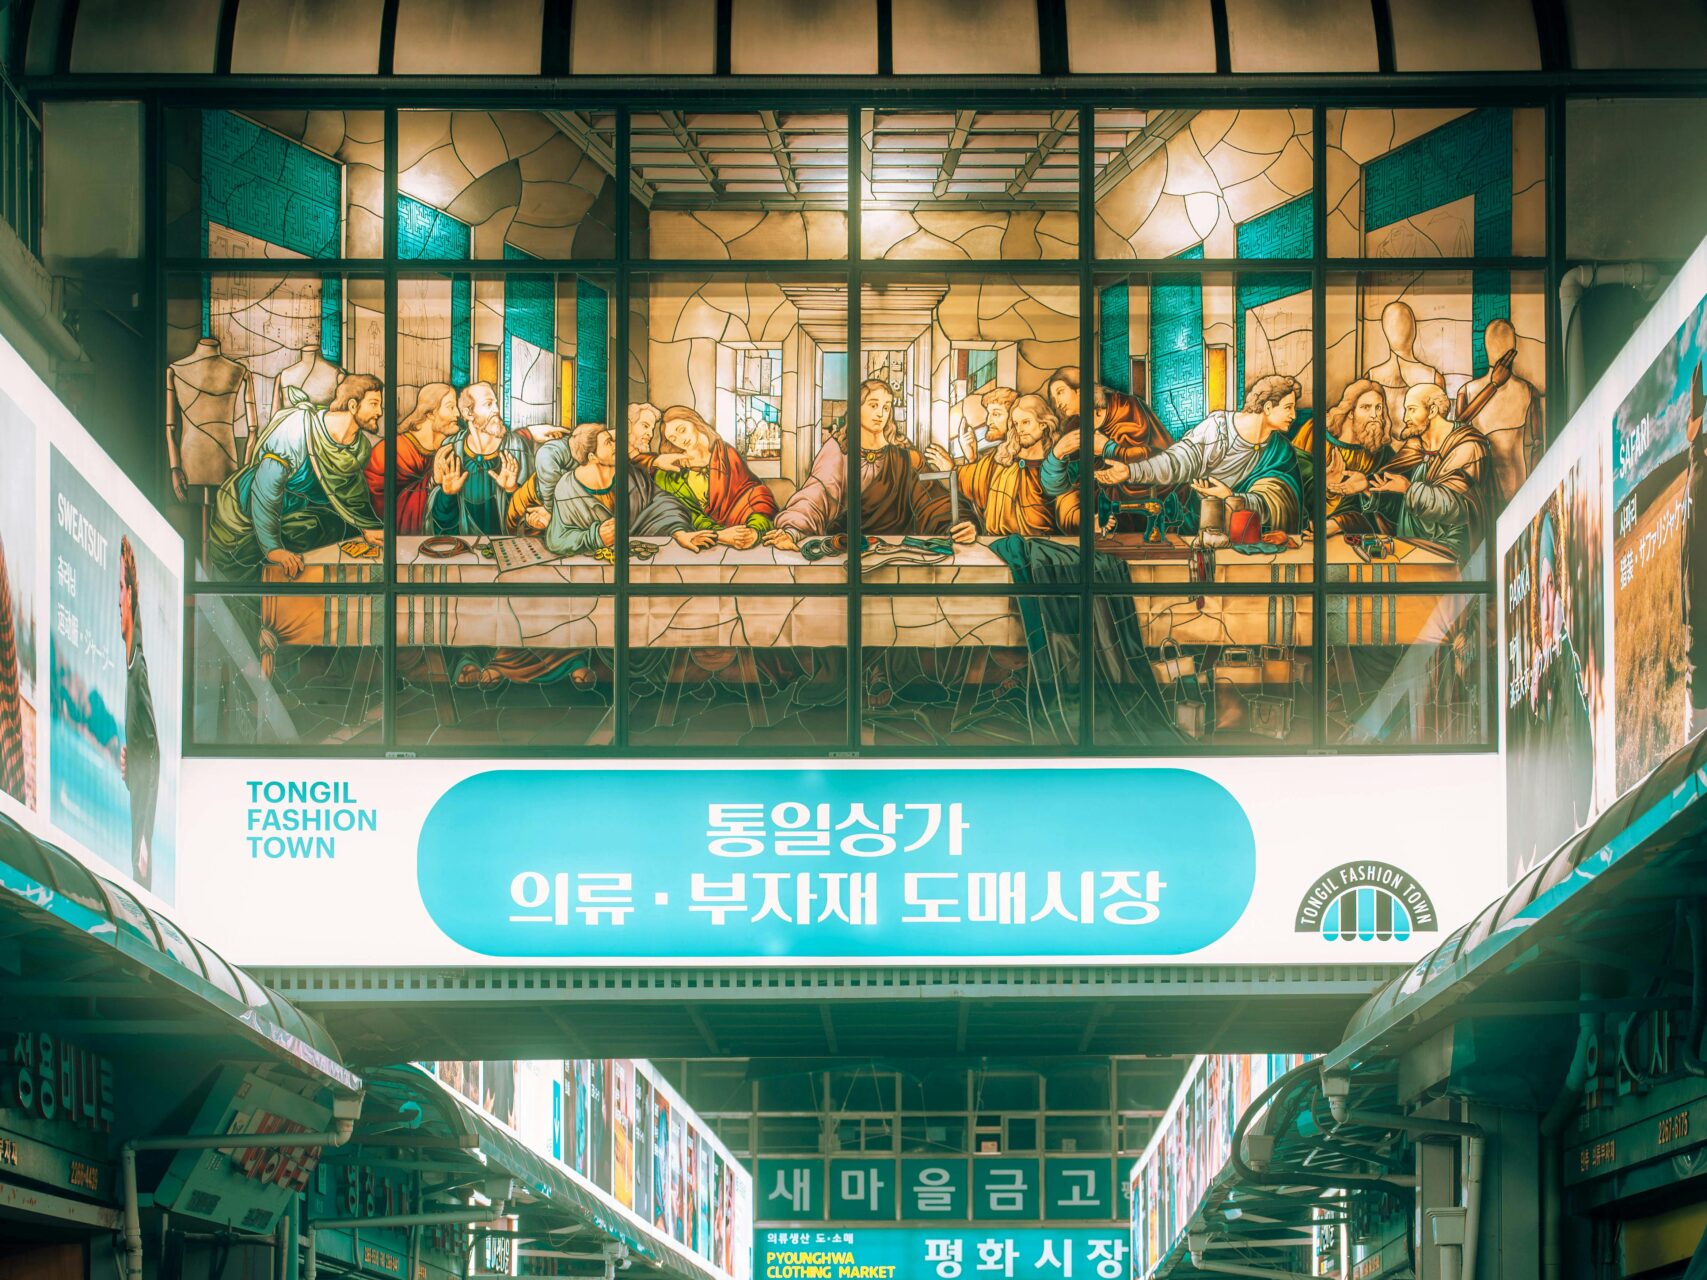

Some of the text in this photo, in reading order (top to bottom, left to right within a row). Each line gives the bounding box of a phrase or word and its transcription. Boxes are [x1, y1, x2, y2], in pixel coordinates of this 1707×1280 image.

[1619, 413, 1650, 479] SAFARI
[57, 492, 108, 571] SWEATSUIT
[1619, 492, 1637, 538] 사파리
[1509, 563, 1530, 614] PARKA
[246, 781, 357, 804] TONGIL
[247, 808, 377, 832] FASHION
[706, 802, 970, 858] 통일상가
[246, 836, 335, 859] TOWN
[901, 870, 1167, 926] 도매시장
[1300, 865, 1432, 925] TONGIL FASHION TOWN
[768, 1167, 1100, 1212] 새마을금고
[766, 1251, 855, 1265] PYOUNGHWA
[767, 1232, 809, 1245] 의류생산
[924, 1238, 1129, 1279] 평화시장
[766, 1265, 896, 1279] CLOTHING MARKET
